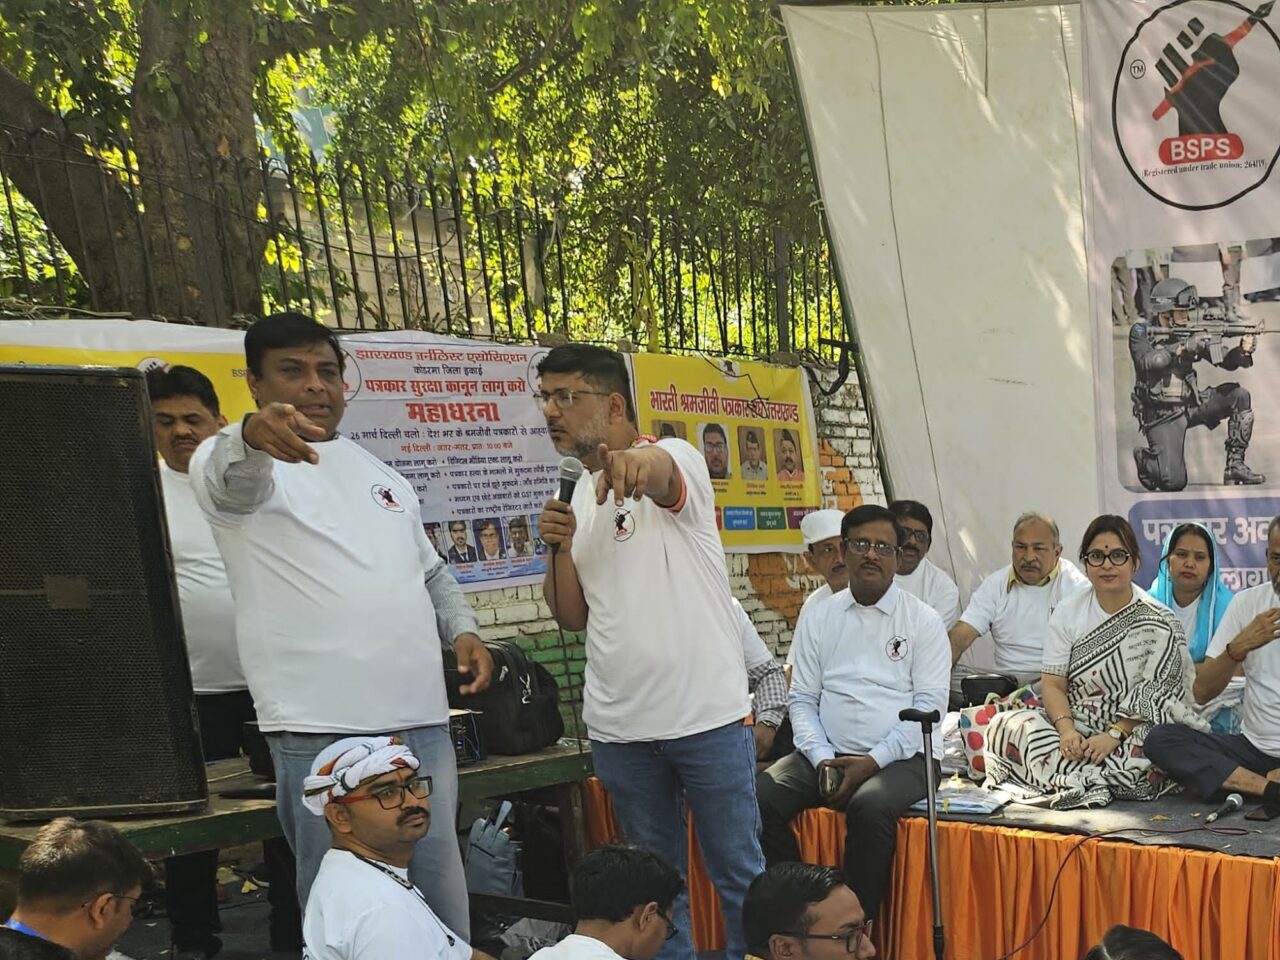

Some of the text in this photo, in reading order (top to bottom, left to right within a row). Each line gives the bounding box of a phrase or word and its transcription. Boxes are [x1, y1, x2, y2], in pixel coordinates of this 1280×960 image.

[1132, 65, 1144, 74] TM
[1170, 138, 1231, 161] BSPS
[1179, 165, 1198, 173] under
[1200, 161, 1217, 170] trade
[365, 377, 525, 397] पत्रकार सुरक्षा कानून लागू करो
[650, 384, 678, 412] भारती
[681, 387, 719, 415] श्रमजीवी
[406, 402, 501, 423] महाधरना
